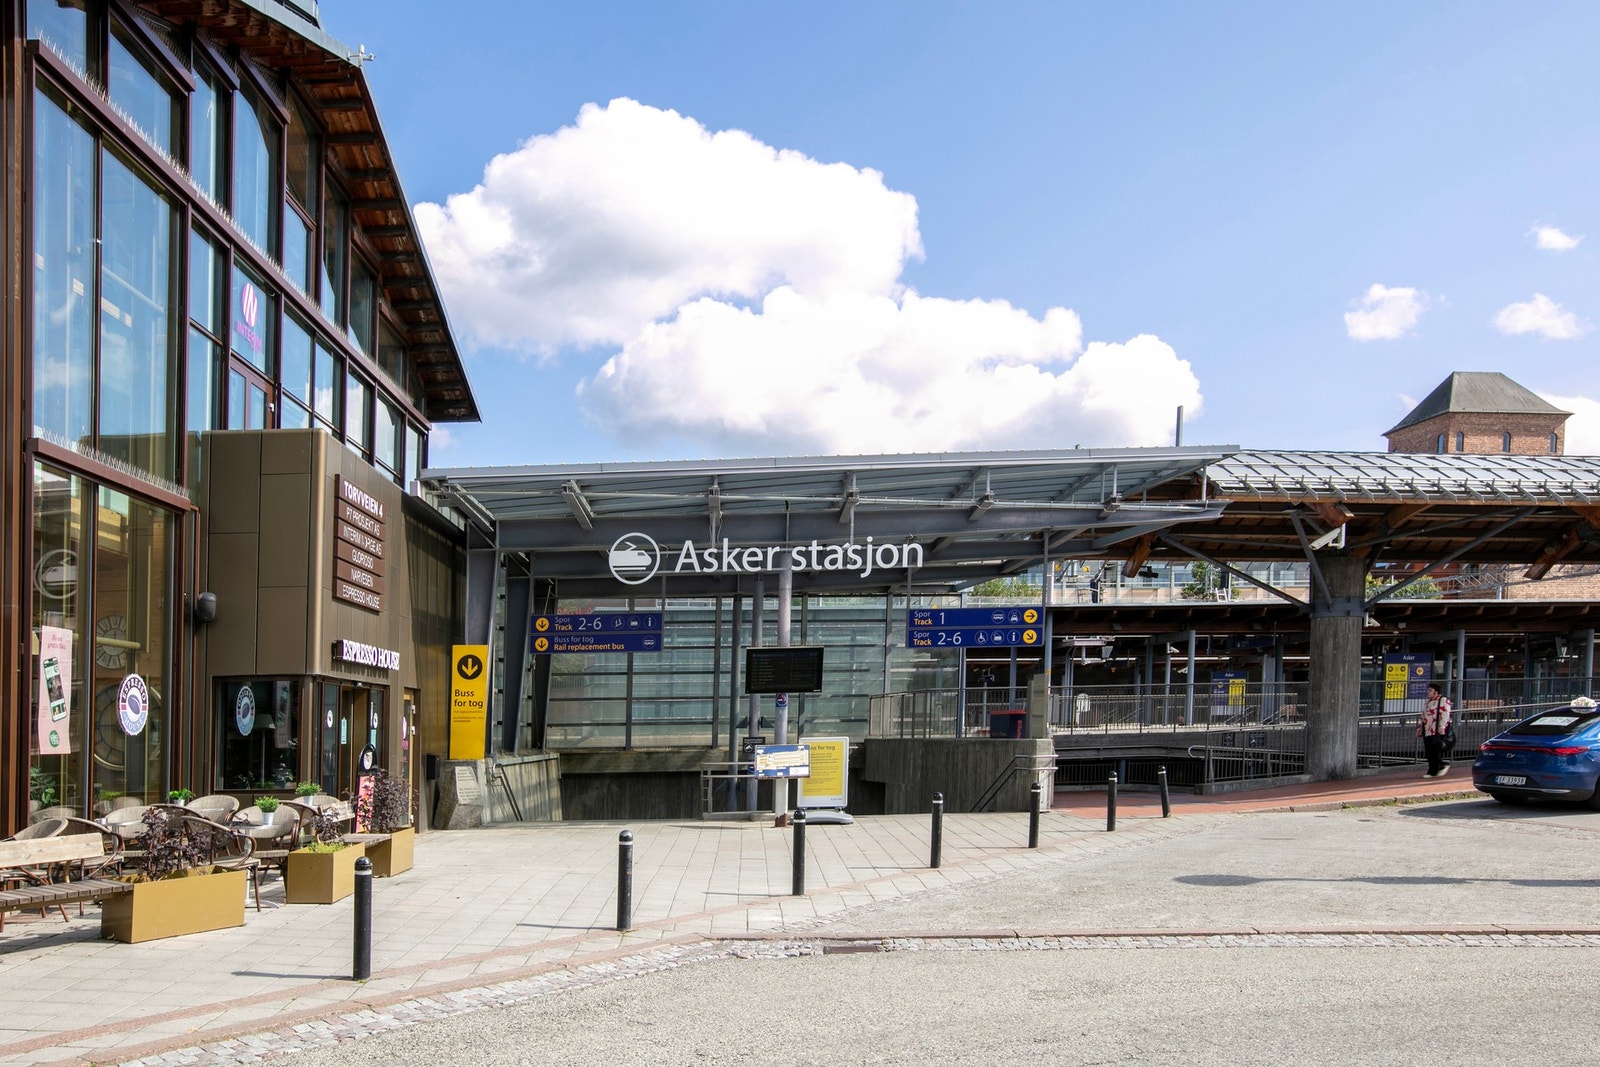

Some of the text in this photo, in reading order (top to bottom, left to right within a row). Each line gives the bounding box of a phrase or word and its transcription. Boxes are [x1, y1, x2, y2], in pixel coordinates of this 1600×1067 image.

[344, 480, 378, 515] TORVVEIEN
[353, 509, 374, 532] PROSJEKT
[374, 524, 380, 536] AS
[375, 543, 382, 555] AS
[674, 536, 923, 578] Asker stasjon
[351, 568, 374, 588] NARVESEN
[342, 584, 380, 609] ESPRESSO HOUSE
[554, 616, 602, 630] Spor 2-6
[939, 612, 945, 624] 1
[582, 636, 594, 644] tog
[913, 630, 962, 645] Spor 2-6
[342, 639, 400, 670] ESPRESSO HOUSE
[568, 644, 610, 652] replacement
[122, 678, 147, 700] ESPRESSO
[454, 689, 474, 697] Buss
[454, 698, 483, 709] for tog
